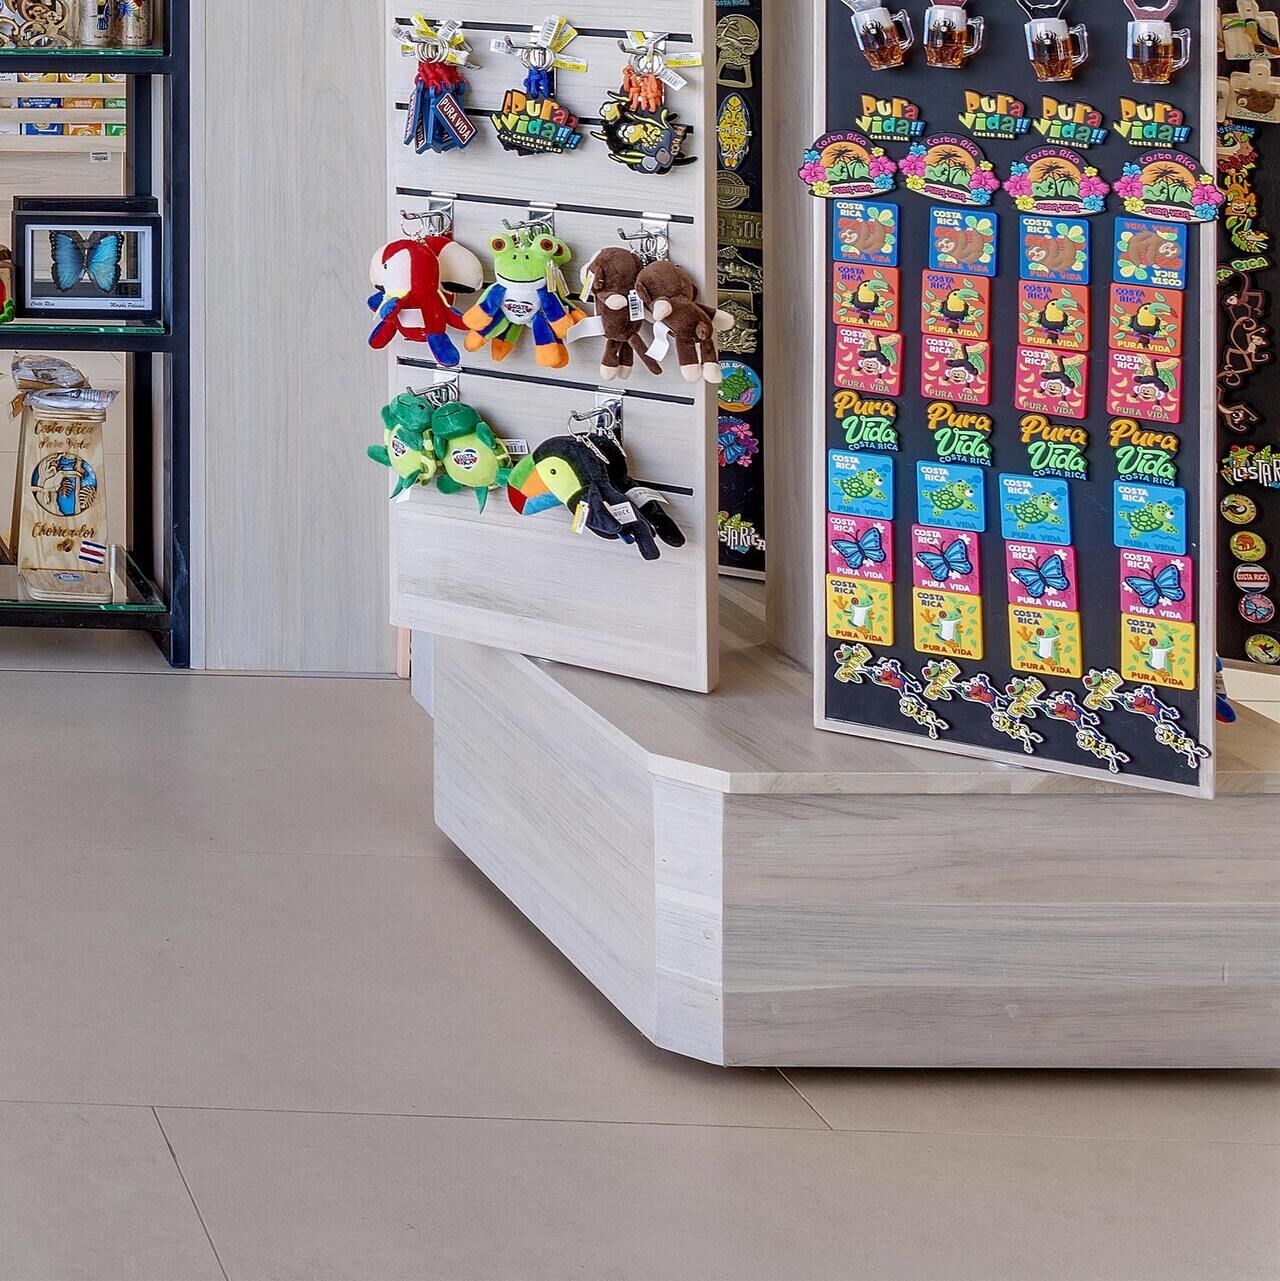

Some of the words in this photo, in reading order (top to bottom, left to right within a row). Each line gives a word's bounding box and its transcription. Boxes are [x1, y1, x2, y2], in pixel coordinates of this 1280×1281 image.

[861, 92, 920, 120] Pura
[440, 98, 460, 122] PURA
[454, 118, 470, 142] VIDA
[815, 133, 845, 150] Costa
[846, 132, 867, 146] Rica
[836, 202, 864, 212] COSTA
[840, 210, 862, 218] RICA
[1023, 218, 1053, 228] COSTA
[1027, 226, 1050, 234] RICA
[842, 252, 867, 262] PURA
[870, 254, 890, 263] VIDA
[929, 324, 954, 334] PURA
[958, 328, 978, 338] VIDA
[833, 391, 896, 419] Pura
[928, 402, 992, 432] Pura
[842, 416, 898, 444] Vida
[1020, 415, 1088, 445] Pura
[1110, 418, 1178, 451] Pura
[848, 441, 876, 450] COSTA
[878, 442, 898, 451] RICA
[934, 428, 991, 458] Vida
[832, 454, 860, 464] COSTA
[940, 454, 968, 464] COSTA
[970, 456, 992, 466] RICA
[1027, 442, 1086, 472] Vida
[1116, 446, 1176, 480] Vida
[836, 462, 858, 470] RICA
[1032, 468, 1062, 478] COSTA
[1064, 470, 1086, 480] RICA
[1119, 472, 1150, 483] COSTA
[1152, 476, 1176, 487] RICA
[1118, 486, 1148, 496] COSTA
[1122, 494, 1146, 504] RICA
[830, 518, 856, 527] COSTA
[834, 524, 854, 533] RICA
[32, 522, 97, 538] Chorreador
[1008, 544, 1038, 554] COSTA
[1012, 552, 1035, 561] RICA
[836, 567, 861, 576] PURA
[864, 570, 884, 580] VIDA
[921, 579, 946, 589] PURA
[950, 582, 971, 592] VIDA
[1017, 596, 1042, 606] PURA
[1046, 598, 1068, 608] VIDA
[1126, 618, 1156, 628] COSTA
[1130, 626, 1154, 636] RICA
[1020, 662, 1046, 672] PURA
[1048, 665, 1072, 676] VIDA
[1131, 671, 1158, 681] PURA
[1160, 675, 1184, 686] VIDA
